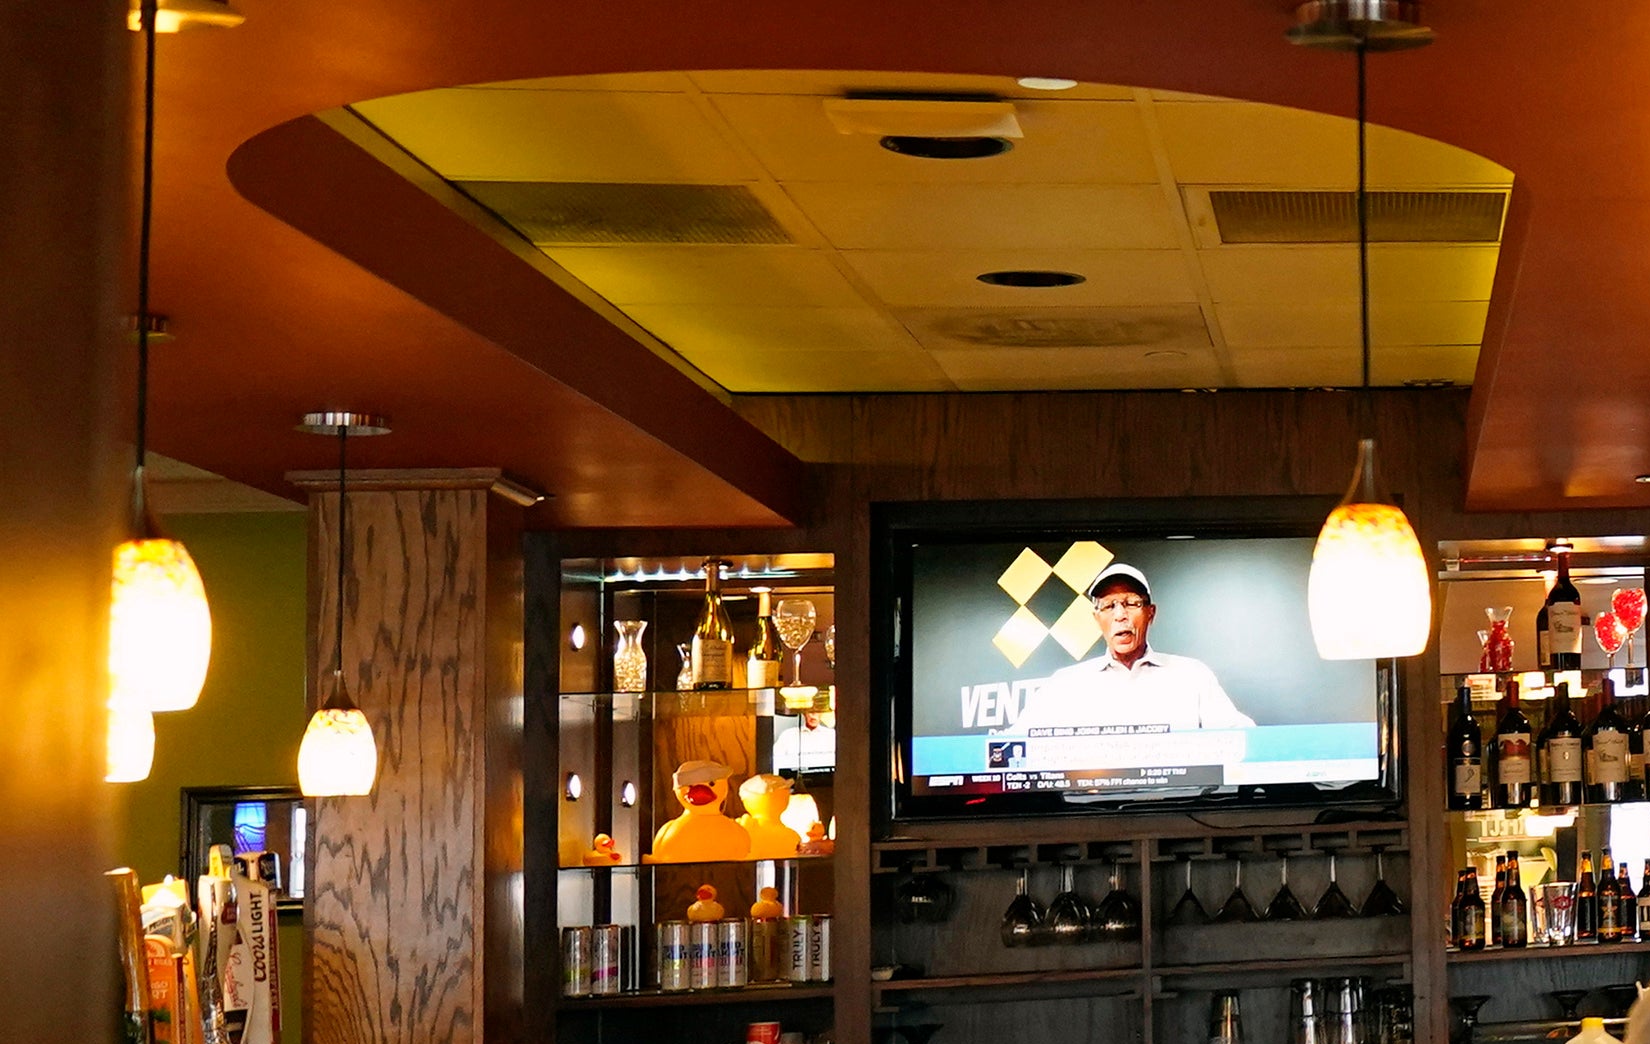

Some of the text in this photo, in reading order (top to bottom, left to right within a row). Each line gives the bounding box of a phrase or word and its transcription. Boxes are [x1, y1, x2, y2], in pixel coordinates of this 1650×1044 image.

[928, 776, 964, 787] ESPN
[250, 891, 267, 983] Coors LIGHT
[792, 930, 804, 970] TRULY
[811, 930, 820, 967] TRULY
